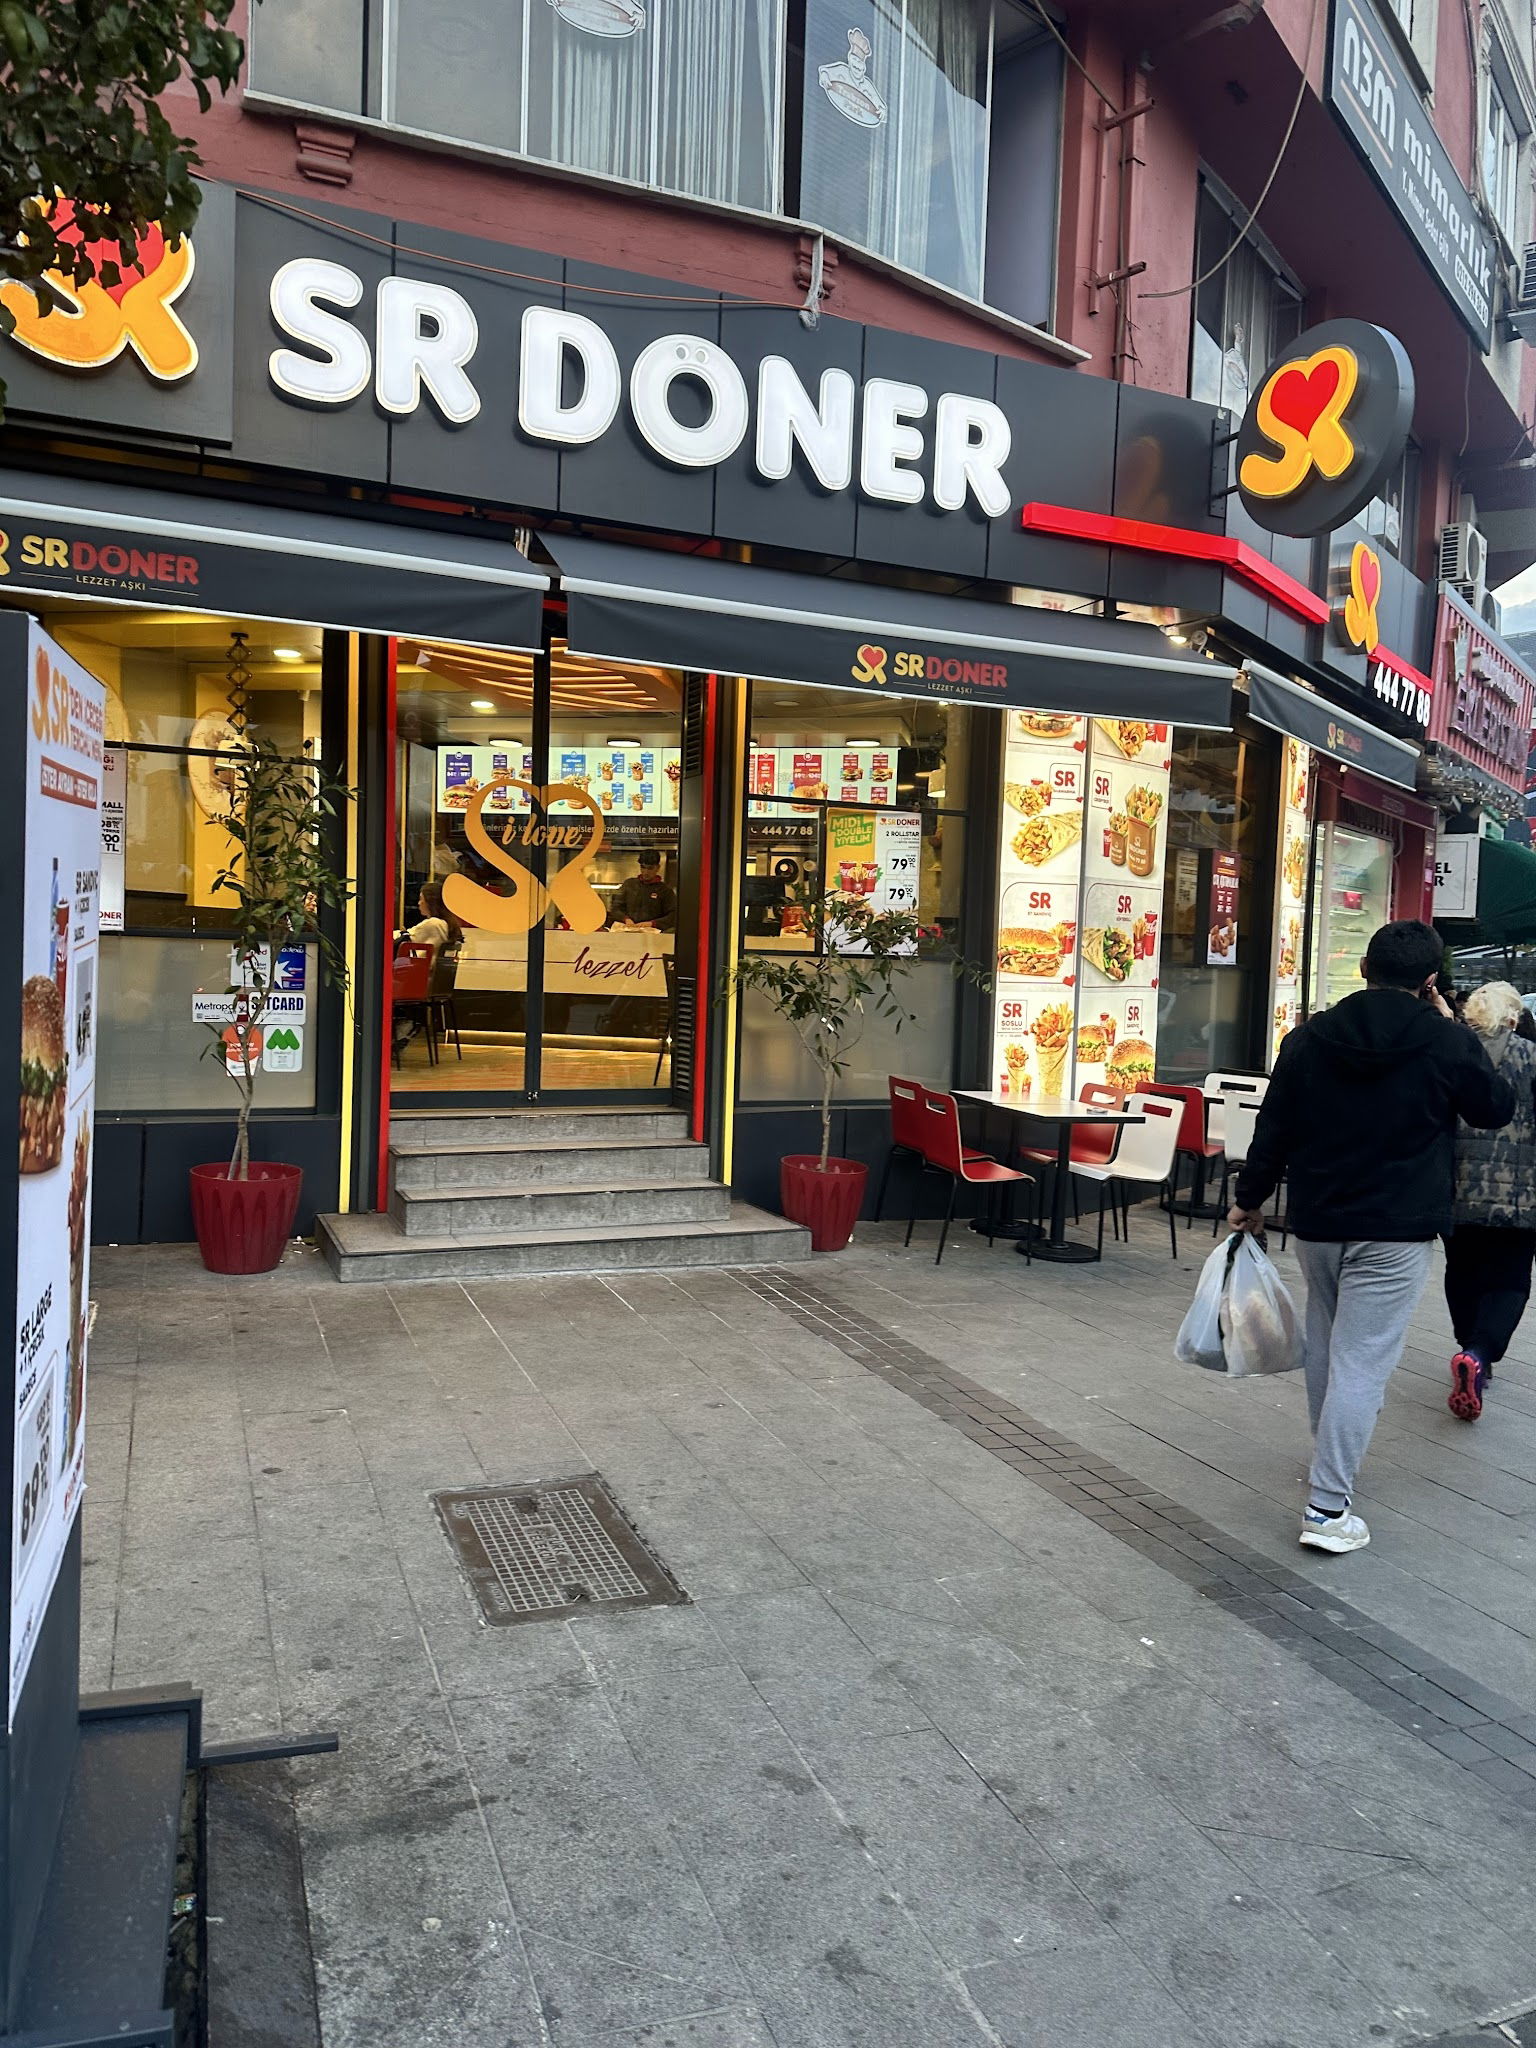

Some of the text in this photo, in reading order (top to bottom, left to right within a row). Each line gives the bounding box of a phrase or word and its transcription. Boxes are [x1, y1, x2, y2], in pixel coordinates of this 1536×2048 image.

[1404, 118, 1491, 297] mimarlık
[268, 256, 1012, 518] SR DÖNER
[20, 534, 69, 569] SR
[76, 575, 146, 591] LEZZET AŞKI
[893, 652, 925, 678] SR
[927, 683, 954, 692] LEZZET
[1374, 661, 1400, 708] 444
[1401, 676, 1416, 716] 77
[1416, 688, 1431, 728] 88
[1054, 770, 1075, 787] SR
[1095, 776, 1110, 796] SR
[521, 812, 583, 847] love
[762, 826, 813, 836] 444 77 88
[105, 842, 119, 852] TL
[892, 858, 908, 870] 79
[889, 888, 905, 900] 79
[1029, 891, 1051, 909] SR
[1117, 895, 1132, 914] SR
[574, 946, 653, 980] lezzet
[1002, 1003, 1022, 1018] SR
[1128, 1006, 1140, 1021] SR
[20, 1282, 52, 1354] SR LARGE
[21, 1461, 39, 1546] 89
